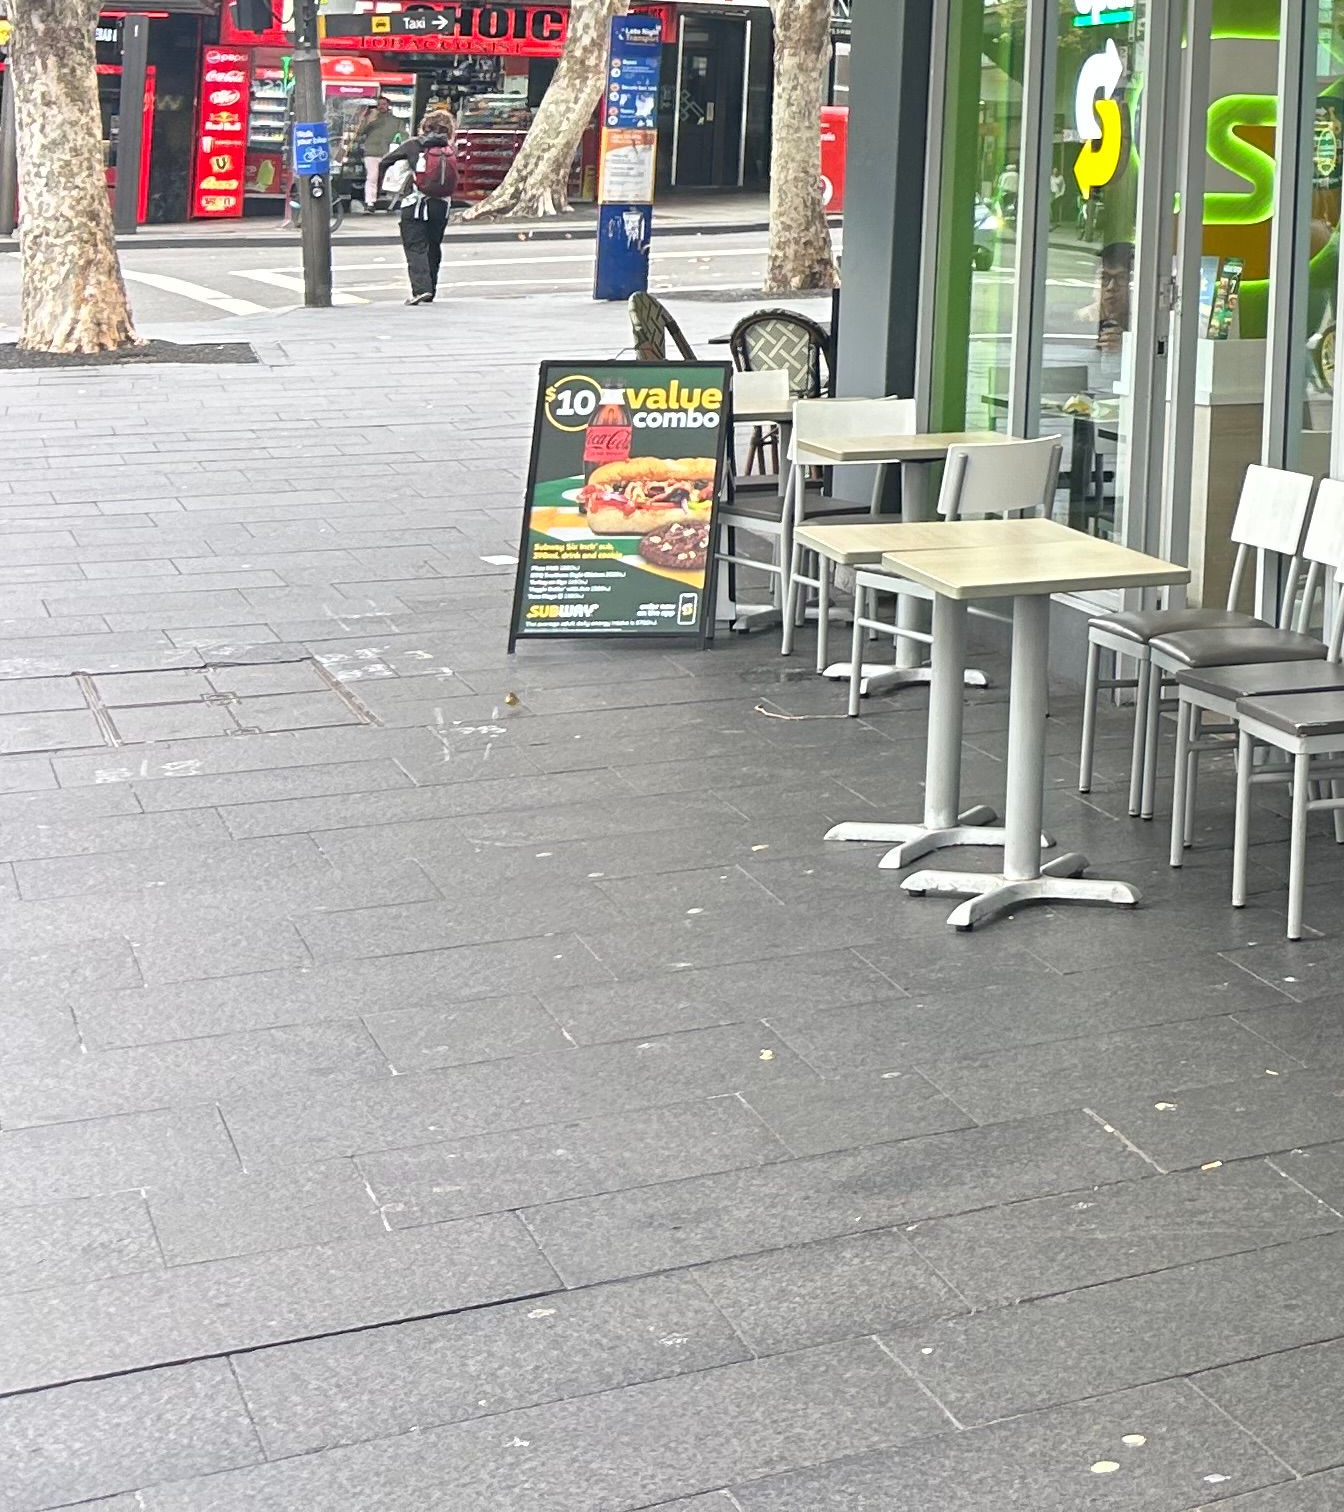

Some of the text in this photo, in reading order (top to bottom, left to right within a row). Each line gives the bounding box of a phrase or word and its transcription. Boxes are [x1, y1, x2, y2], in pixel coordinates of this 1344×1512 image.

[403, 17, 426, 30] Taxi
[626, 380, 723, 410] value
[632, 407, 721, 428] combo
[526, 603, 600, 619] SUBWAY
